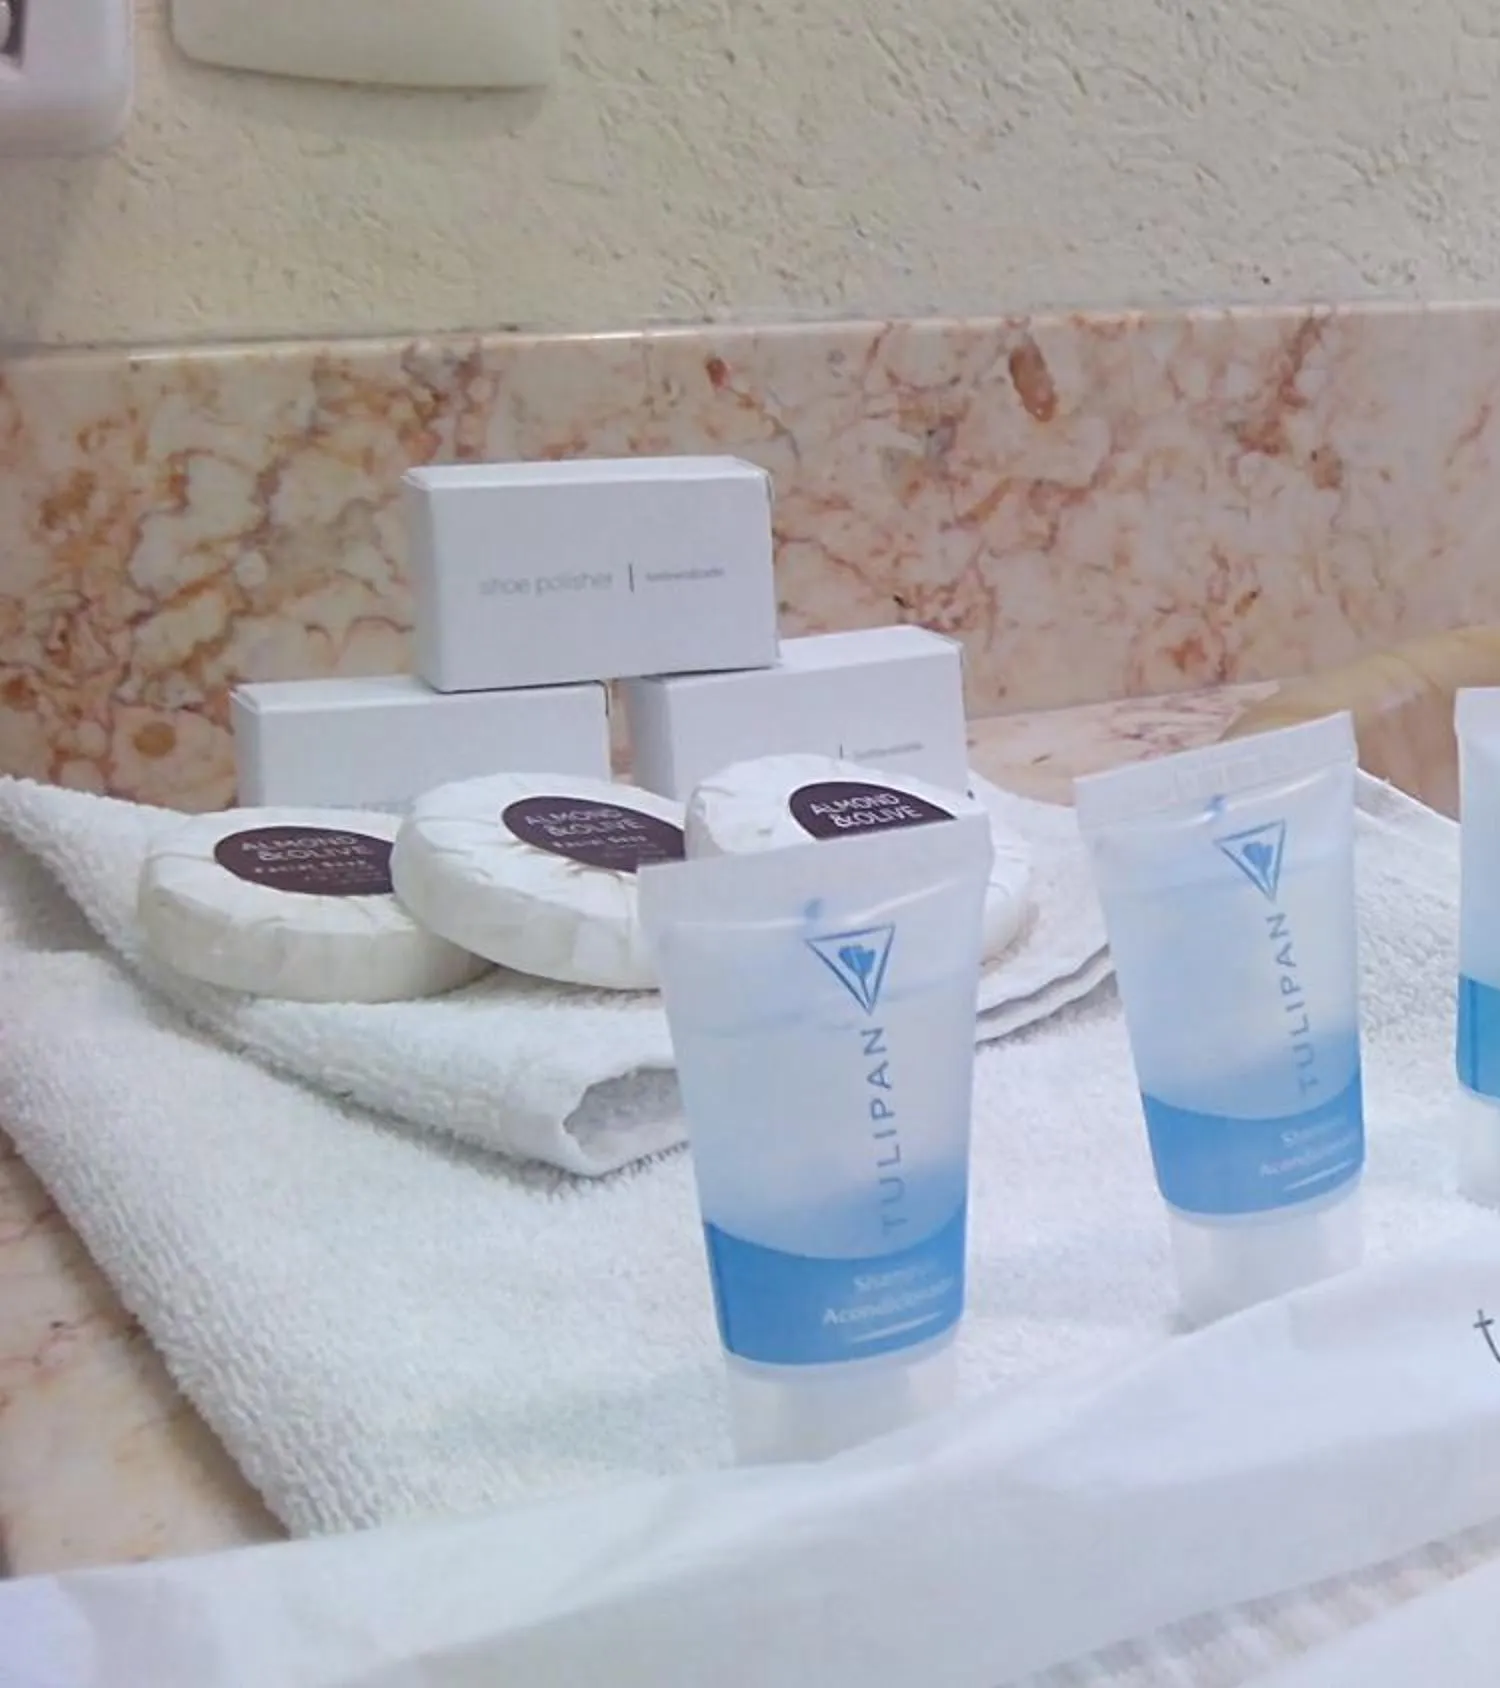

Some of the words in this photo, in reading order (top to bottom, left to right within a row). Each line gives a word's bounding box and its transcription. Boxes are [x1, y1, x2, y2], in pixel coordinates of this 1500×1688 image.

[810, 792, 900, 816] ALMOND
[828, 805, 923, 829] &OLIVE
[1264, 912, 1320, 1094] TULIPAN
[860, 1026, 909, 1236] TULIPAN
